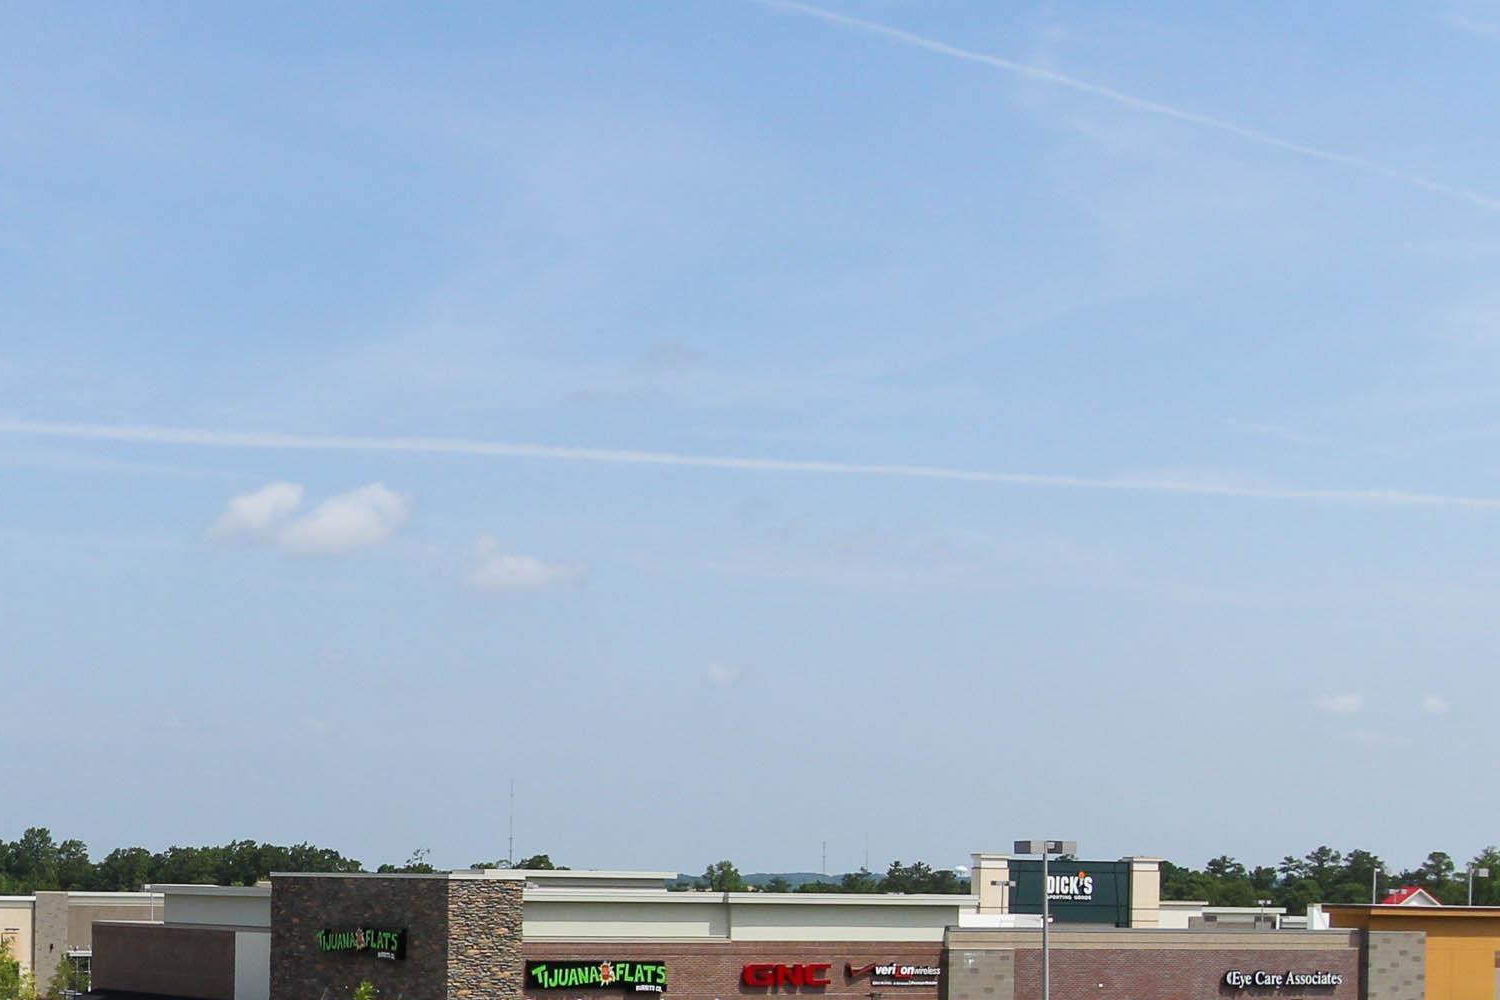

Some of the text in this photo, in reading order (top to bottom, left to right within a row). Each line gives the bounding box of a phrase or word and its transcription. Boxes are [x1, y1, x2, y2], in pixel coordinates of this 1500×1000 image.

[1047, 875, 1093, 895] DICK'S
[316, 929, 399, 952] TIJUANA FLATS
[531, 963, 667, 989] TIJUANA FLATS
[743, 963, 831, 987] GNC
[1255, 971, 1283, 985] Care
[1285, 971, 1343, 985] Associates
